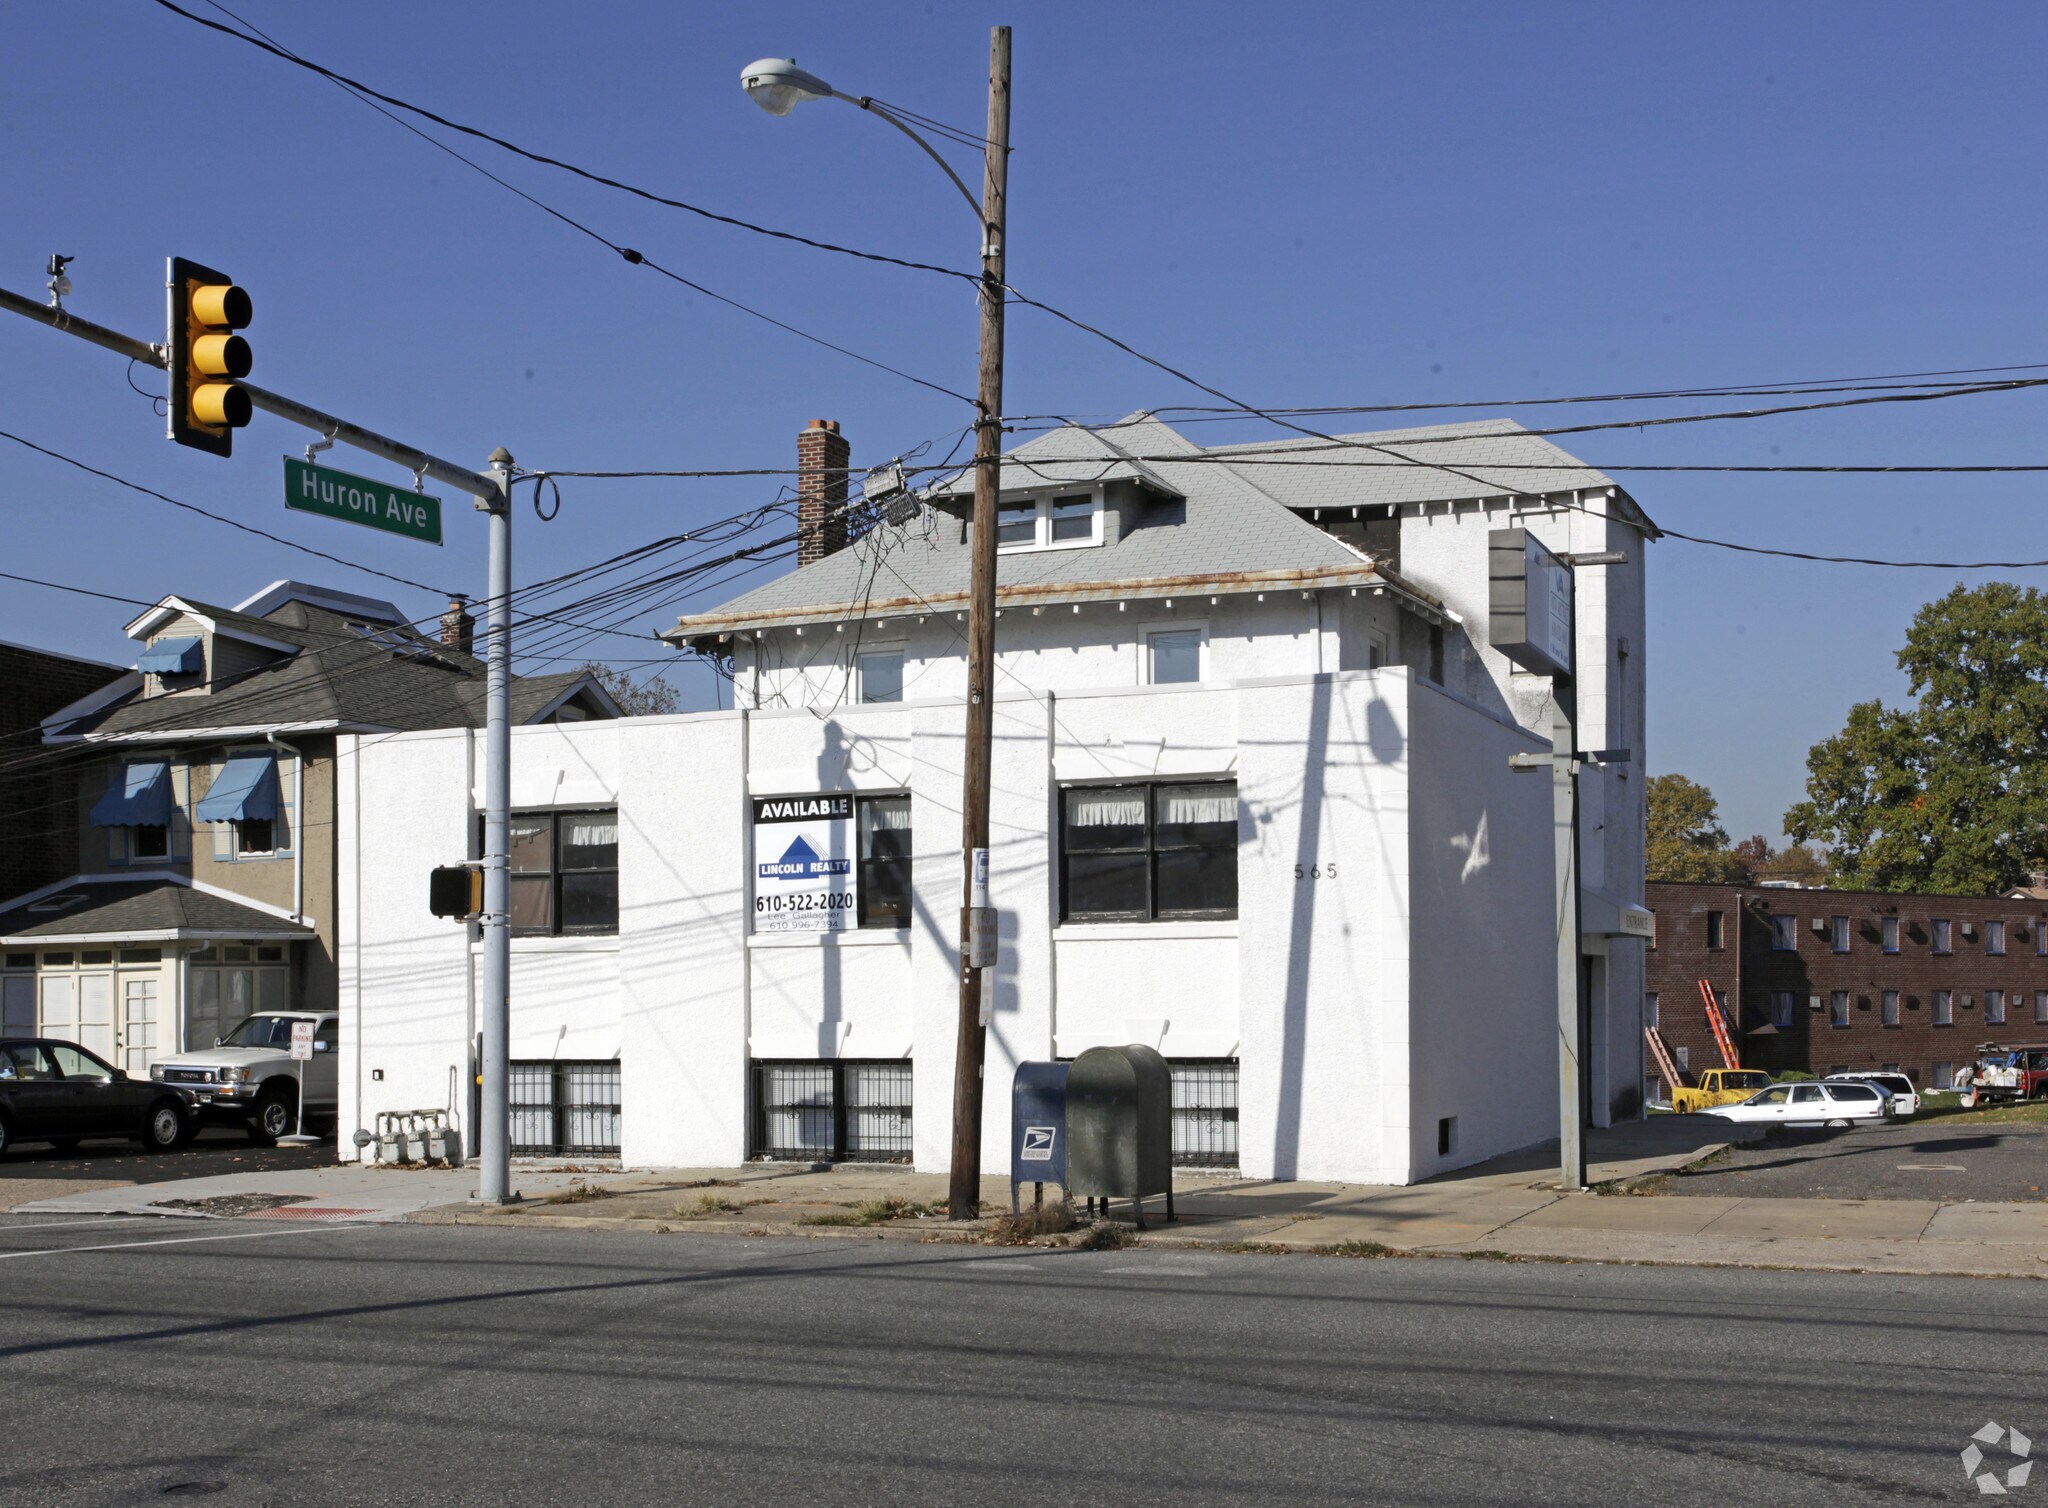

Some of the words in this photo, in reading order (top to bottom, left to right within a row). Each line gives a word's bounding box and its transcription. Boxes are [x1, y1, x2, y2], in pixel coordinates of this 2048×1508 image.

[302, 469, 377, 515] Huron
[386, 493, 427, 528] Ave
[760, 798, 848, 819] AVAILABLE
[761, 863, 804, 875] LINCOLN
[810, 860, 848, 873] REALTY
[1294, 862, 1338, 880] 565
[756, 892, 853, 912] 610-522-2020
[767, 913, 786, 921] Lee
[792, 911, 841, 921] Gallagher
[769, 921, 789, 930] 610
[791, 920, 839, 929] 996-7394
[298, 1025, 307, 1033] NO
